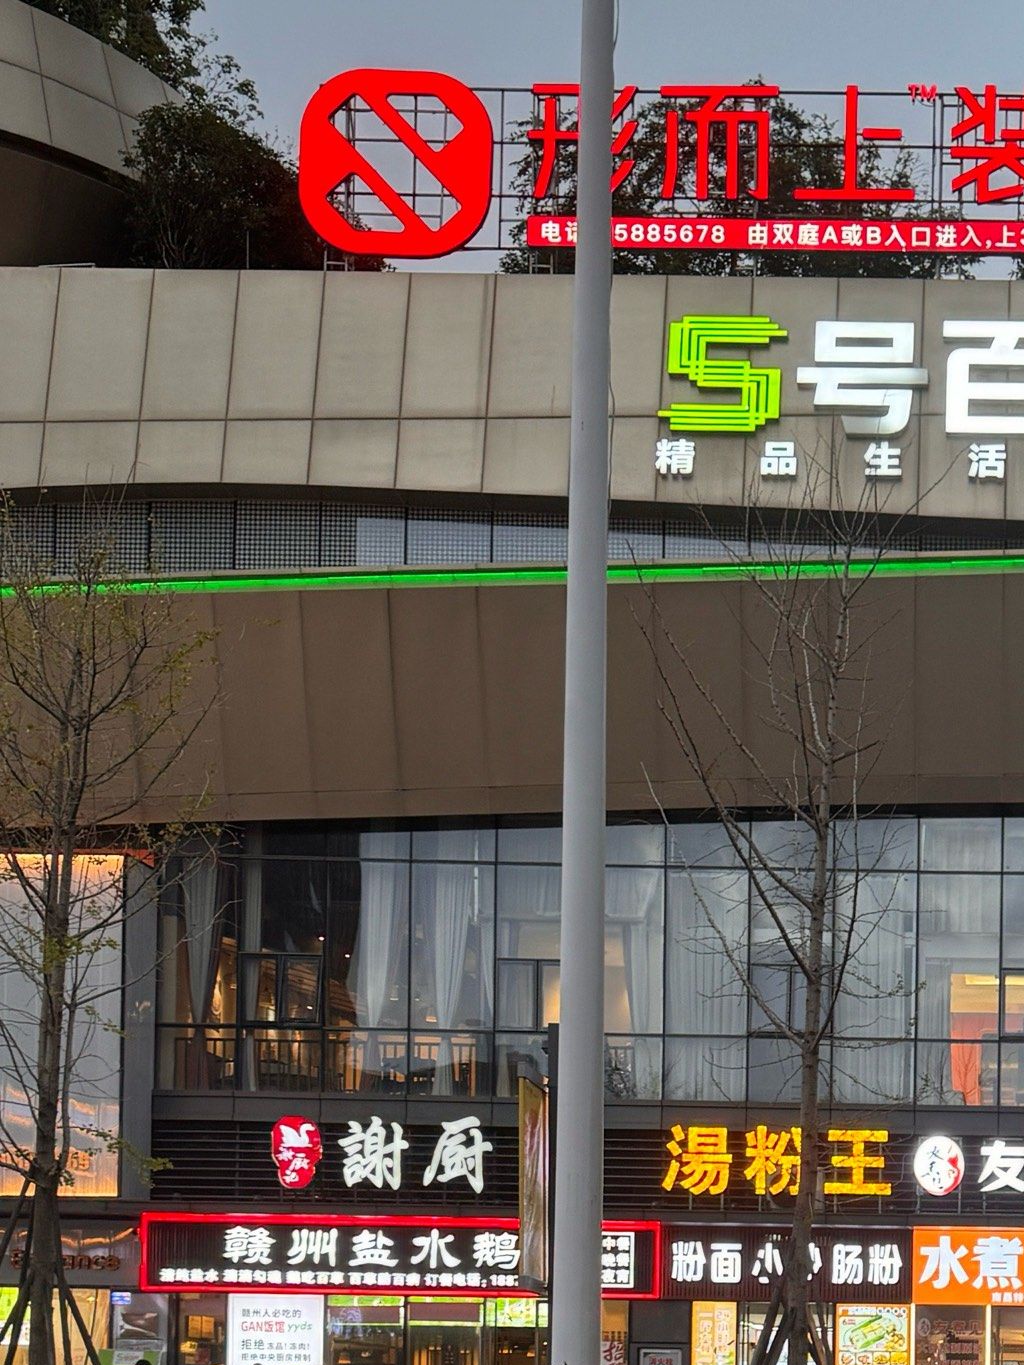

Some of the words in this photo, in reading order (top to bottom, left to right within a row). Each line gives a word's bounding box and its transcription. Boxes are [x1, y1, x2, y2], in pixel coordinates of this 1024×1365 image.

[526, 83, 915, 200] 形而上
[222, 1225, 521, 1270] 赣州盐水鹅
[287, 1321, 313, 1333] yyds
[241, 1339, 265, 1351] 拒绝
